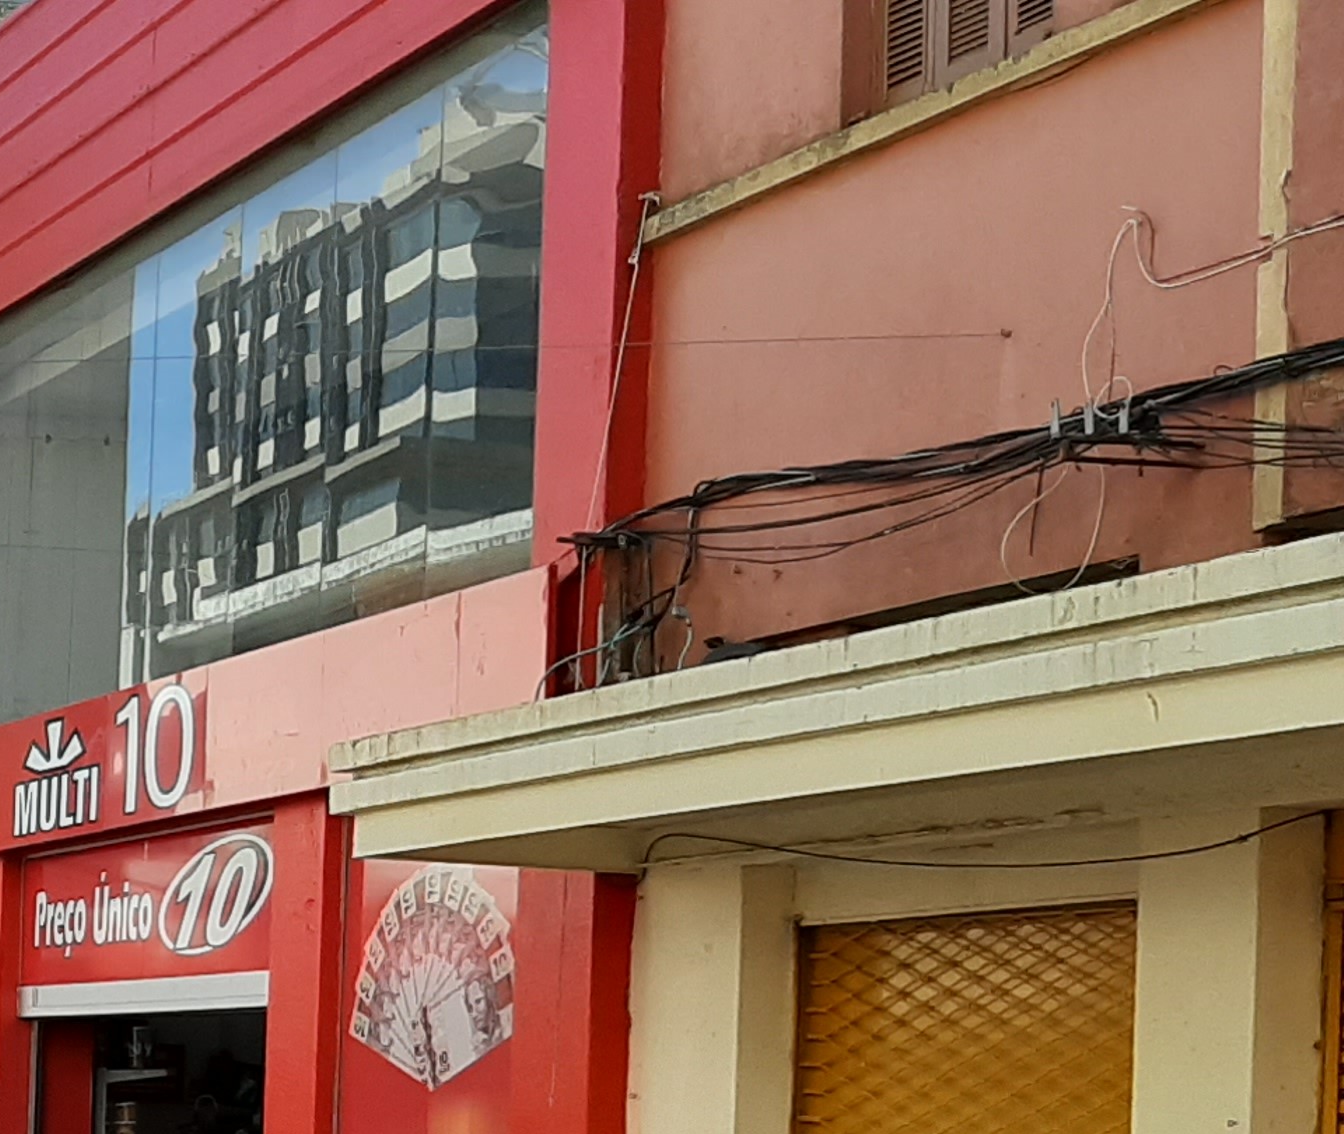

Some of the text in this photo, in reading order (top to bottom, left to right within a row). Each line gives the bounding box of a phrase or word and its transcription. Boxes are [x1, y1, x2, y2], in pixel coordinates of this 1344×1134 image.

[13, 683, 195, 837] MULTI 10
[34, 847, 259, 958] Preço Único 10
